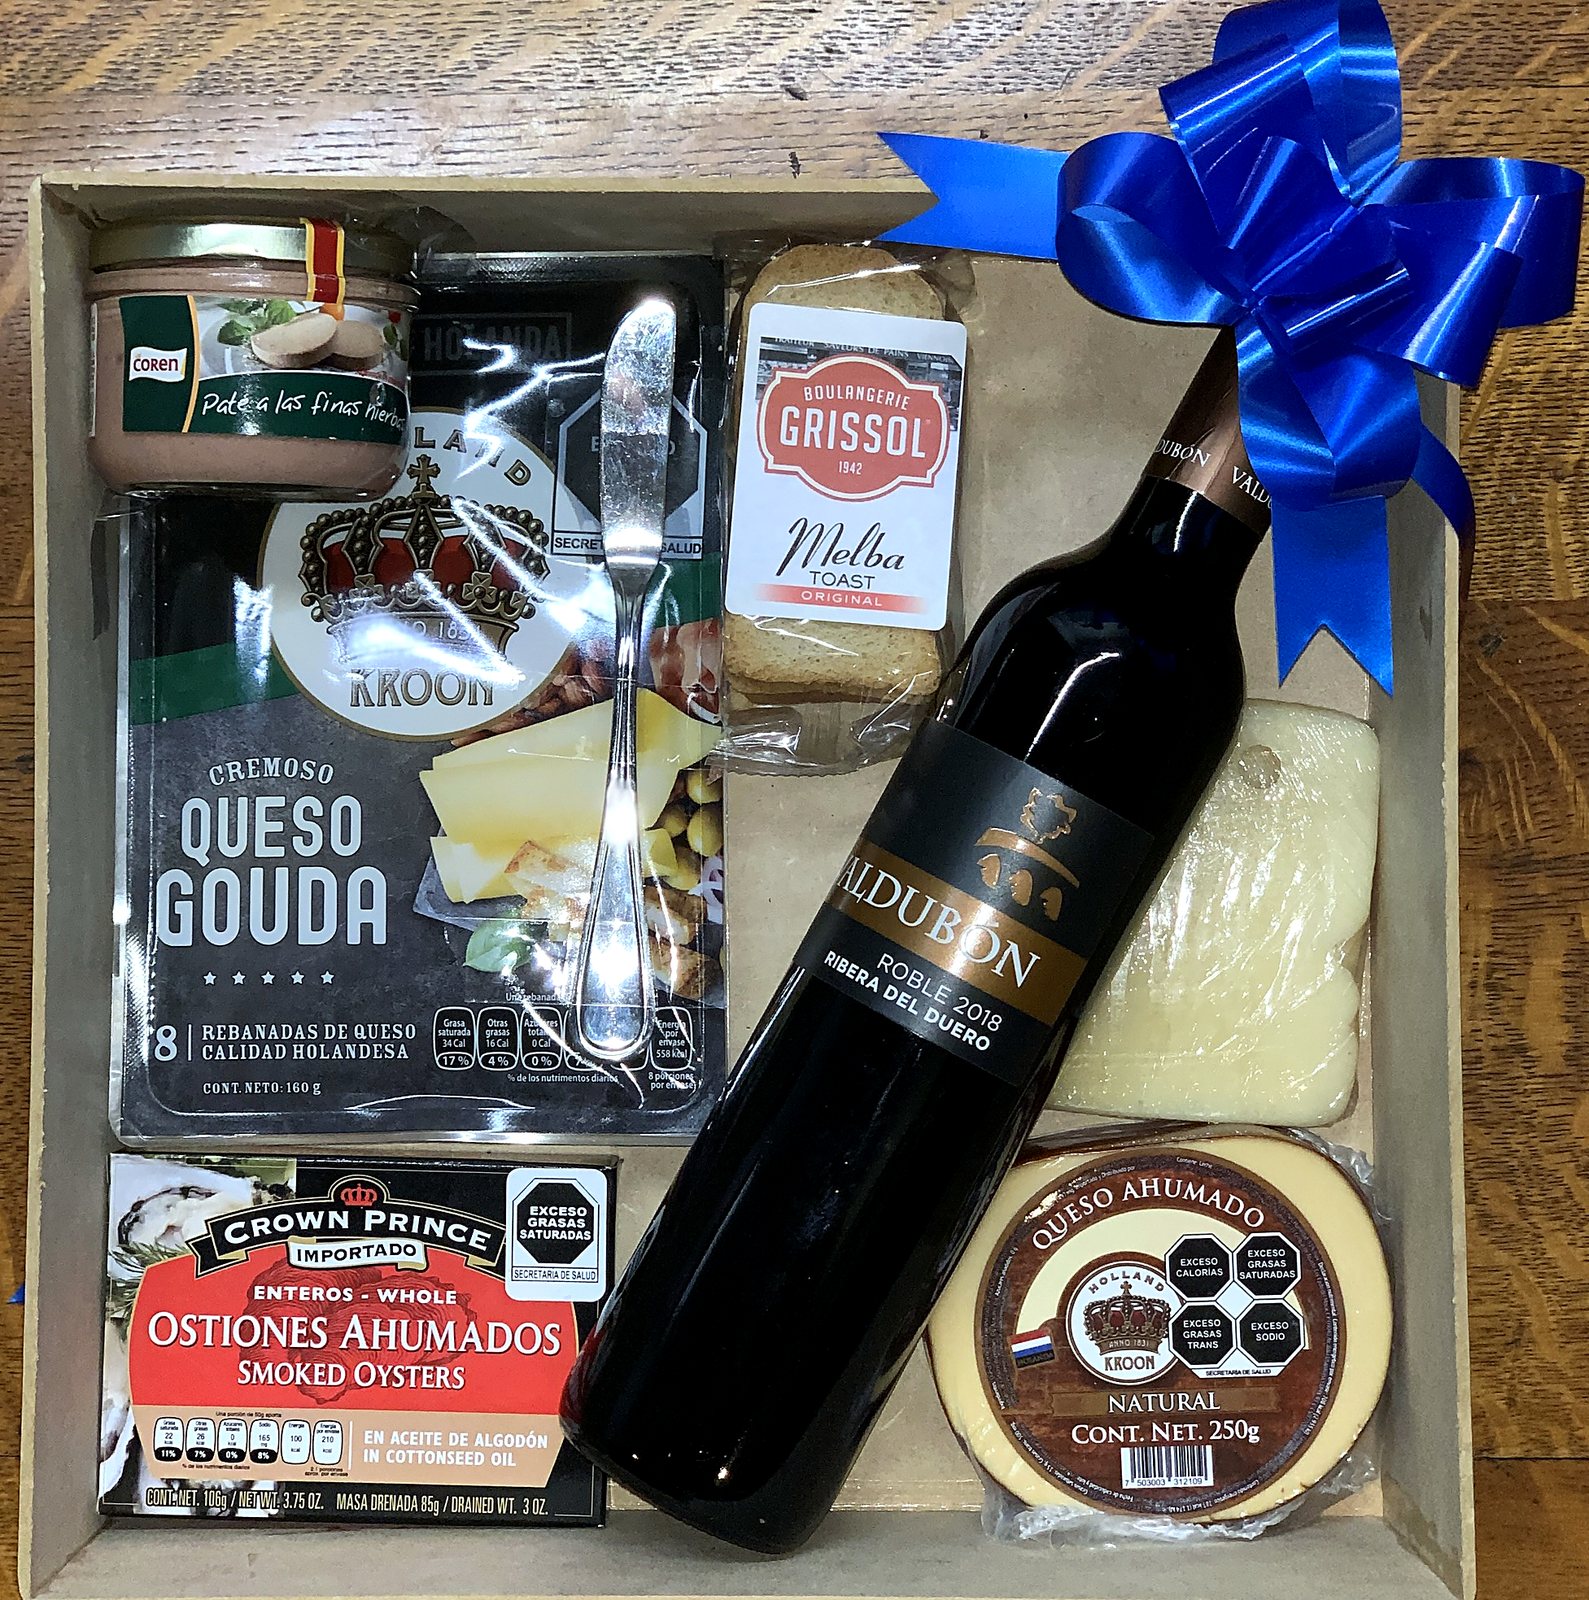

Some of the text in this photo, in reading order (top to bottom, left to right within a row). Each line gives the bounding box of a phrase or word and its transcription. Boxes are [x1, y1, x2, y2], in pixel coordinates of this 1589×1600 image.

[257, 397, 269, 412] a
[275, 390, 305, 414] las
[311, 391, 362, 415] finas
[803, 385, 910, 411] BOULANGERIE
[780, 406, 926, 459] GRISSOL
[414, 426, 532, 487] LAND
[838, 460, 863, 475] 1942
[775, 517, 905, 577] Melba
[809, 571, 876, 590] TOAST
[801, 590, 883, 607] ORIGINAL
[350, 667, 494, 708] KROON
[208, 757, 334, 786] CREMOSO
[181, 795, 362, 867] QUESO
[155, 865, 388, 947] GOUDA
[837, 854, 1041, 989] ALDUBÓN
[876, 953, 1003, 1032] ROBLE 2018
[823, 950, 991, 1051] RIBERA DEL DUERO
[443, 1019, 466, 1028] Grasa
[487, 1019, 508, 1028] Otras
[202, 1023, 416, 1040] REBANADAS DE QUESO
[438, 1027, 471, 1036] saturada
[485, 1028, 510, 1039] grasas
[665, 1030, 679, 1039] por
[154, 1025, 178, 1062] 8
[442, 1038, 466, 1048] 34 Cal
[486, 1038, 509, 1048] 16 Cal
[532, 1038, 551, 1048] 0 Cal
[658, 1039, 686, 1047] envase
[202, 1043, 409, 1060] CALIDAD HOLANDESA
[656, 1049, 671, 1058] 558
[442, 1056, 470, 1066] 17 %
[488, 1056, 509, 1066] 4 %
[531, 1056, 553, 1066] 0 %
[516, 1073, 527, 1082] de
[528, 1073, 540, 1082] los
[541, 1073, 591, 1082] nutrimentos
[648, 1071, 654, 1080] 8
[203, 1082, 322, 1096] CONT. NETO: 160 g
[650, 1082, 665, 1091] por
[529, 1205, 588, 1217] EXCESO
[1032, 1188, 1114, 1250] QUESO
[1122, 1177, 1266, 1228] AHUMADO
[527, 1217, 586, 1228] GRASAS
[223, 1210, 492, 1252] CROWN PRINCE
[519, 1229, 592, 1240] SATURADAS
[296, 1243, 417, 1263] IMPORTADO
[1247, 1249, 1286, 1258] EXCESO
[1180, 1257, 1219, 1267] EXCESO
[1247, 1259, 1287, 1269] GRASAS
[560, 1270, 570, 1280] DE
[571, 1270, 596, 1281] SALUD
[1175, 1267, 1224, 1278] CALORÍAS
[1239, 1269, 1296, 1280] SATURADAS
[1088, 1270, 1165, 1295] HOLLAND
[253, 1285, 354, 1302] ENTEROS
[376, 1288, 457, 1305] WHOLE
[1183, 1318, 1221, 1328] EXCESO
[1250, 1321, 1290, 1331] EXCESO
[147, 1311, 562, 1356] OSTIONES AHUMADOS
[1182, 1330, 1222, 1339] GRASAS
[1255, 1332, 1286, 1342] SODIO
[1187, 1340, 1219, 1349] TRANS
[1104, 1355, 1156, 1372] KROON
[237, 1359, 466, 1391] SMOKED OYSTERS
[1108, 1391, 1221, 1413] NATURAL
[1071, 1423, 1145, 1445] CONT.
[1151, 1421, 1203, 1443] NET.
[1209, 1419, 1261, 1443] 250g
[258, 1434, 271, 1442] 165
[364, 1430, 548, 1449] EN ACEITE DE ALGODÓN
[161, 1450, 176, 1458] 11%
[194, 1450, 207, 1458] 7%
[225, 1451, 238, 1459] 0%
[257, 1451, 270, 1460] 8%
[363, 1449, 516, 1467] IN COTTONSEED OIL
[1125, 1477, 1203, 1487] 7 503003 312109
[147, 1489, 177, 1506] CONT.
[178, 1490, 200, 1507] NET.
[203, 1491, 227, 1511] 106g
[238, 1492, 258, 1508] NET
[283, 1492, 306, 1509] 3.75
[308, 1493, 324, 1510] OZ.
[336, 1493, 368, 1512] MASA
[370, 1494, 419, 1513] DRENADA
[421, 1495, 440, 1516] 85g
[451, 1496, 494, 1514] DRAINED
[498, 1497, 518, 1515] WT.
[523, 1497, 529, 1515] 3
[532, 1498, 549, 1516] OZ.
